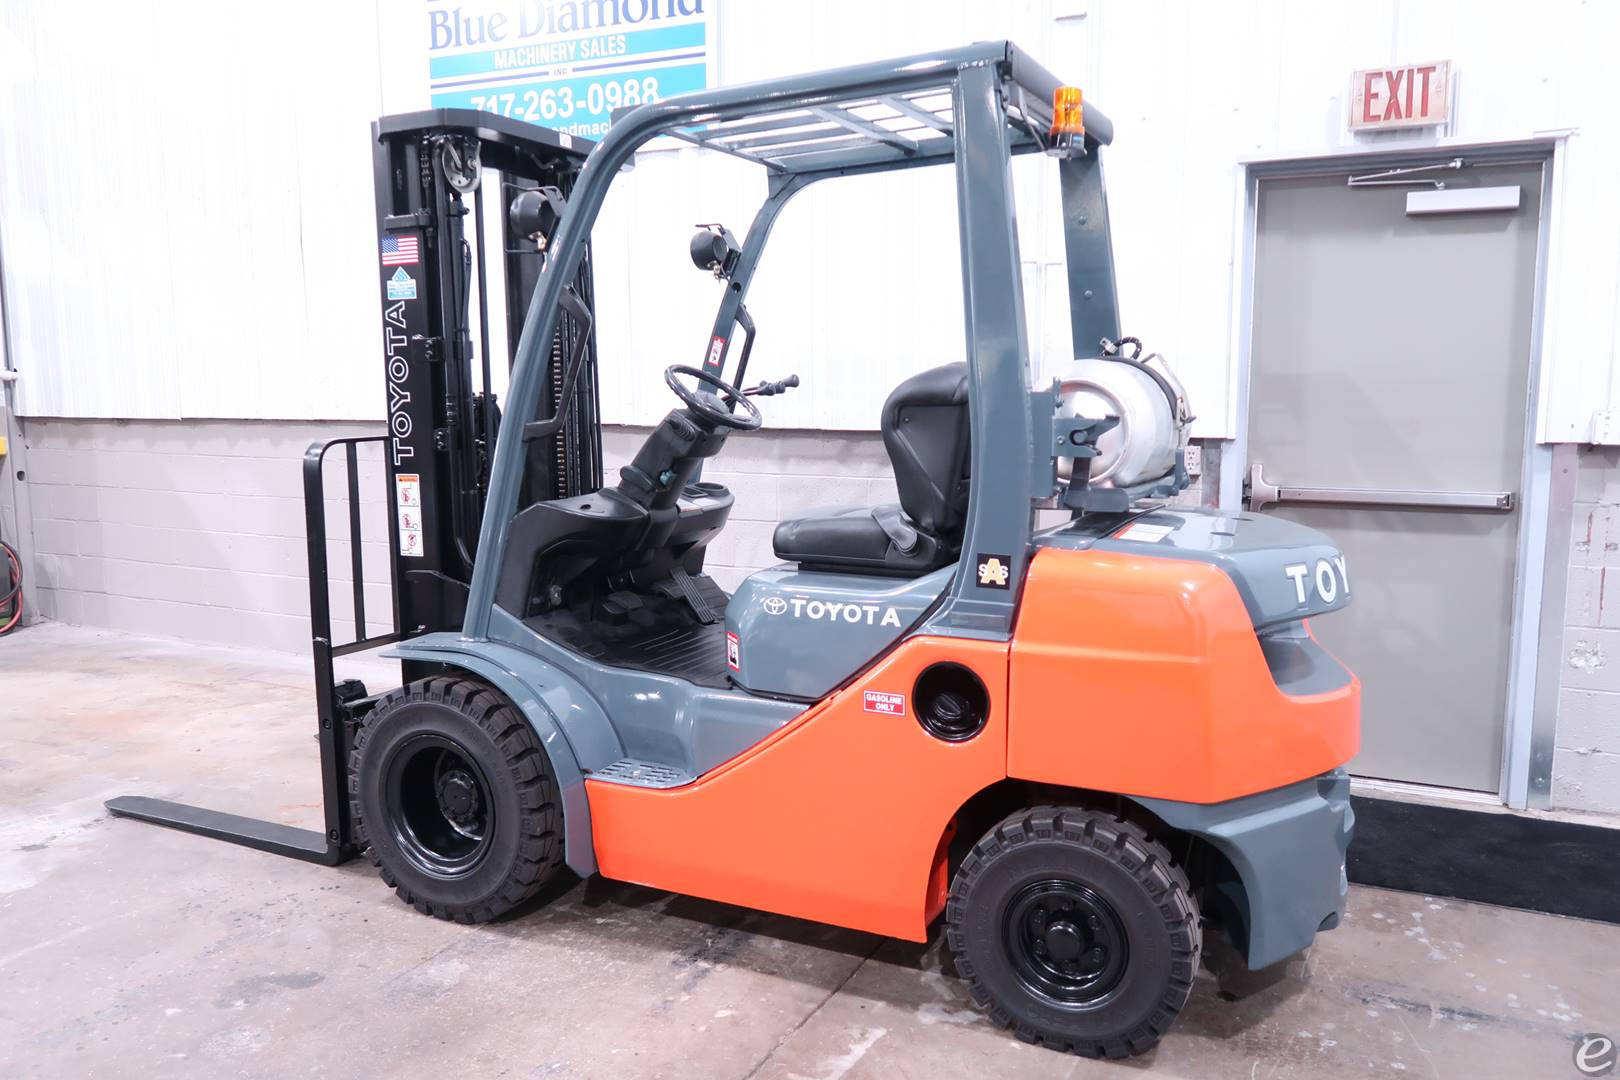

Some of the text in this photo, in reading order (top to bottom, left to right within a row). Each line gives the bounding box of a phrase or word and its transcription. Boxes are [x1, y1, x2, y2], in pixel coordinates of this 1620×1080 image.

[428, 7, 508, 50] Blue
[494, 34, 627, 70] MACHINERY SALES
[470, 76, 660, 122] 717-263-0988
[1363, 66, 1437, 123] EXIT
[385, 300, 414, 466] TOYOTA
[791, 598, 901, 627] TOYOTA
[866, 693, 903, 704] GASOLINE
[875, 702, 895, 712] ONLY
